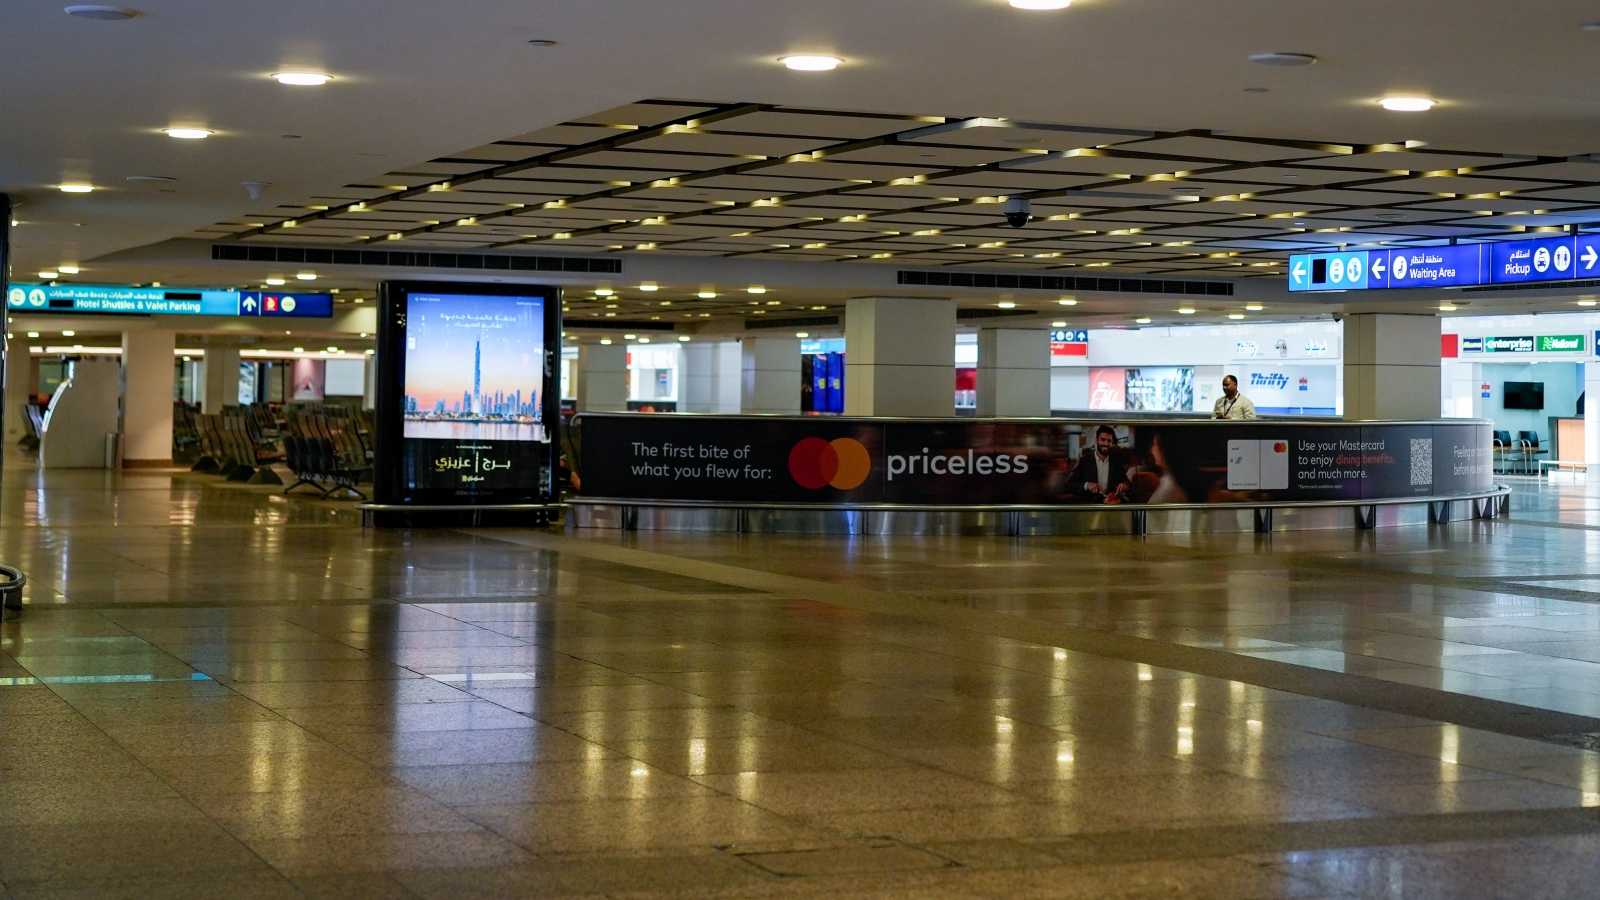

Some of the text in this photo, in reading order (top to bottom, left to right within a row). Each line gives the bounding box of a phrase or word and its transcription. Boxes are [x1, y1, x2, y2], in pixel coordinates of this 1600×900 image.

[1409, 267, 1456, 280] Waiting Area
[1505, 263, 1530, 276] Pickup
[76, 299, 201, 313] Hotel Shuttles & Valet Parking
[1487, 338, 1532, 350] enterprise
[1551, 339, 1578, 348] National
[1250, 373, 1289, 390] Thrifty
[631, 442, 751, 459] The first bite of
[1298, 439, 1385, 453] Use your Mastercard
[1454, 445, 1471, 460] Feeling
[435, 456, 511, 471] برج عزيزي
[887, 447, 1029, 481] priceless
[1298, 453, 1395, 467] to enjoy dining benefits,
[631, 462, 772, 480] what you flew for:
[1298, 468, 1368, 479] and much more.
[1453, 462, 1469, 475] before
